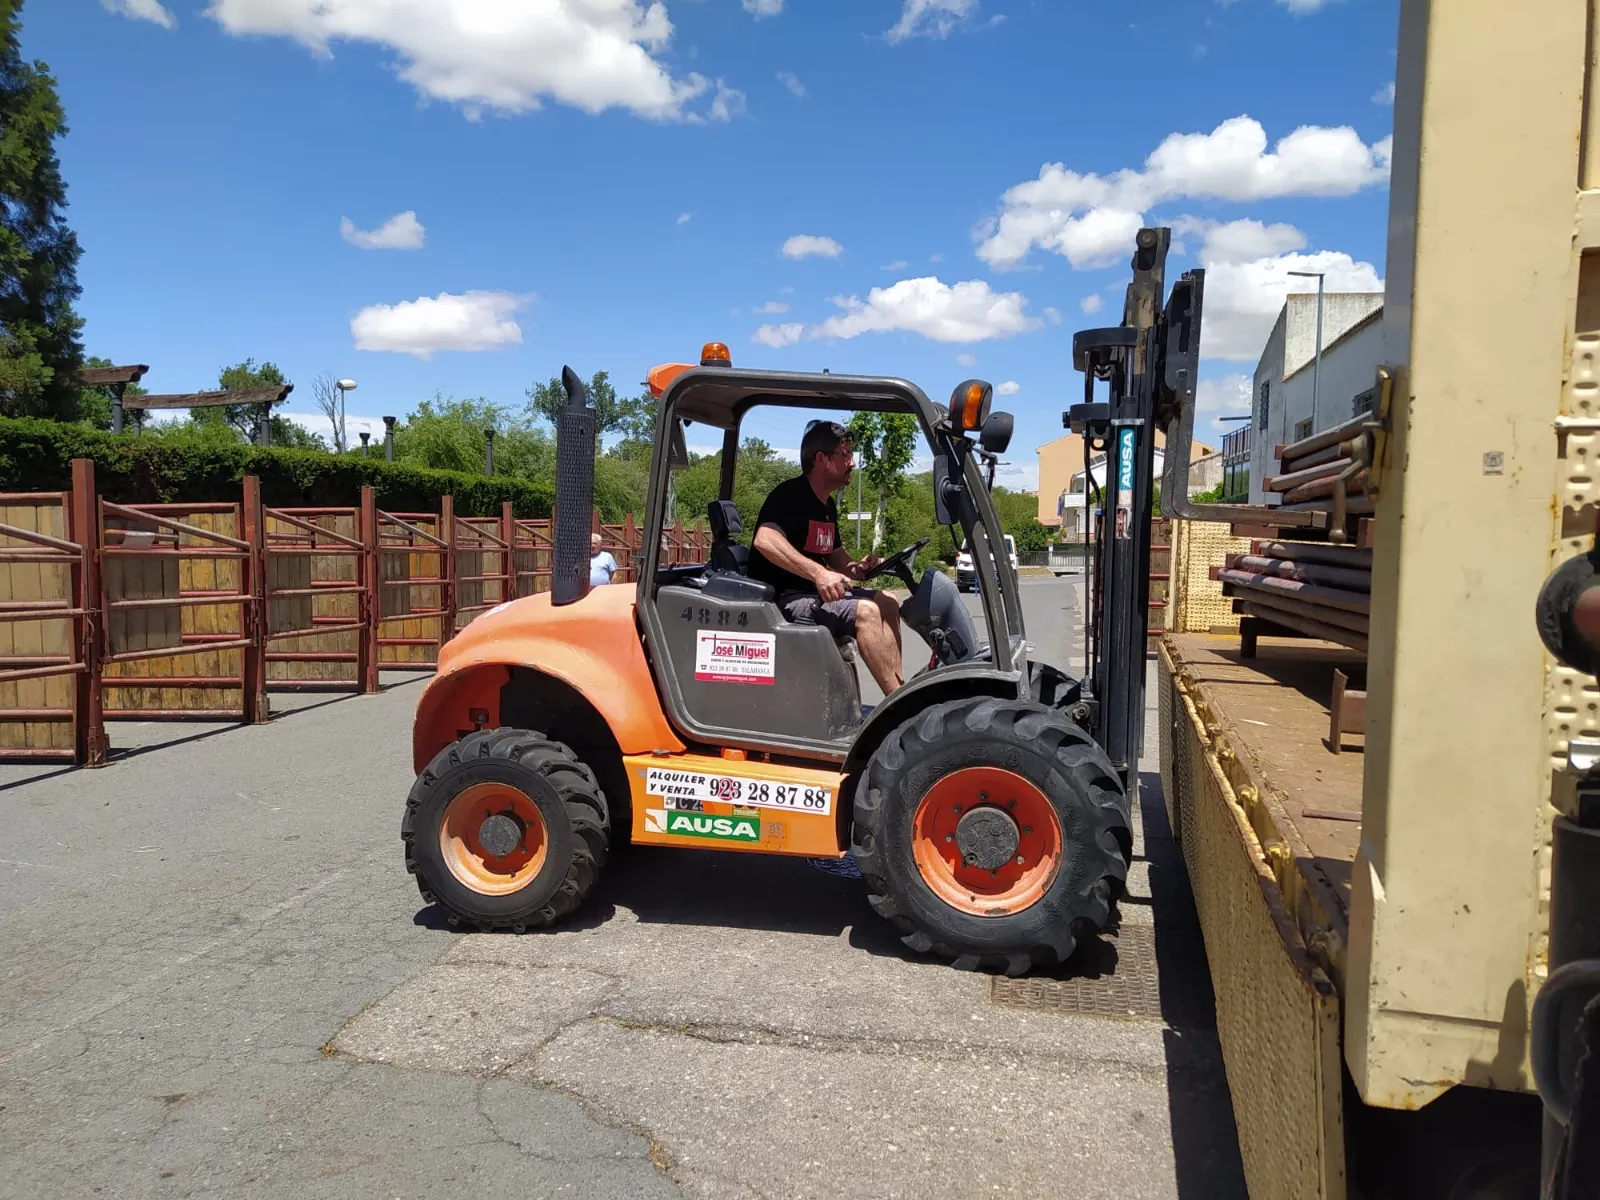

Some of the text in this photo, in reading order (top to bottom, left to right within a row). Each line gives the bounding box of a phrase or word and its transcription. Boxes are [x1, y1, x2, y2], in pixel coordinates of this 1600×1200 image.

[1121, 431, 1133, 488] AUSA
[711, 634, 733, 656] José
[650, 771, 706, 785] ALQUILER
[660, 784, 695, 796] VENTA
[710, 778, 826, 809] 923 28 87 88
[670, 816, 757, 838] AUSA
